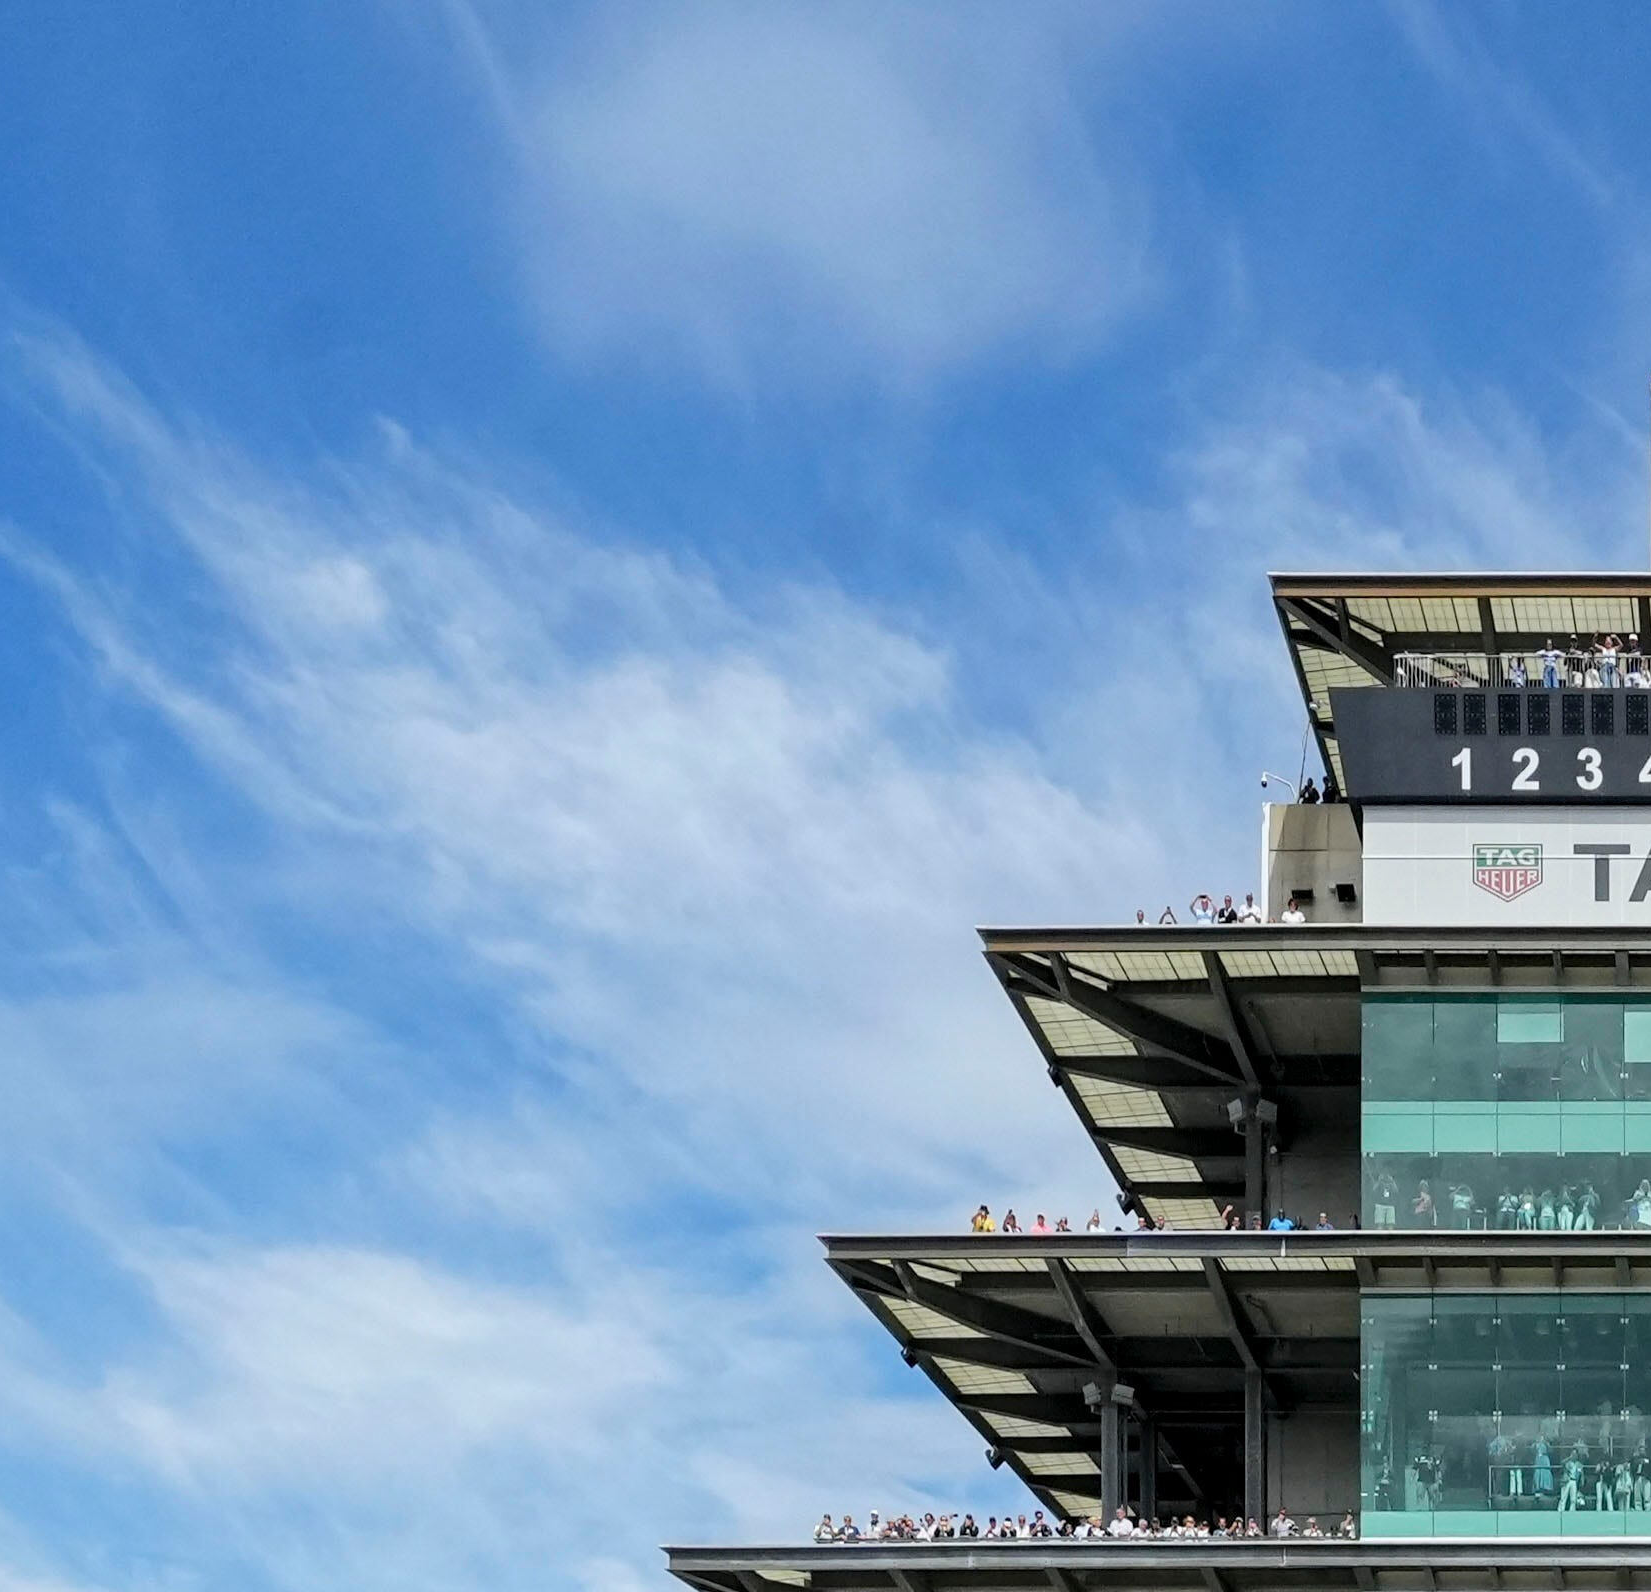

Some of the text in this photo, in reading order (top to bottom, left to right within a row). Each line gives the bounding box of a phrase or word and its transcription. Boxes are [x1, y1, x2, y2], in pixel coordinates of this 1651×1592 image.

[1452, 748, 1471, 790] 1
[1512, 748, 1540, 791] 2
[1577, 748, 1604, 791] 3
[1478, 848, 1538, 867] TAG
[1478, 868, 1539, 900] HEUER
